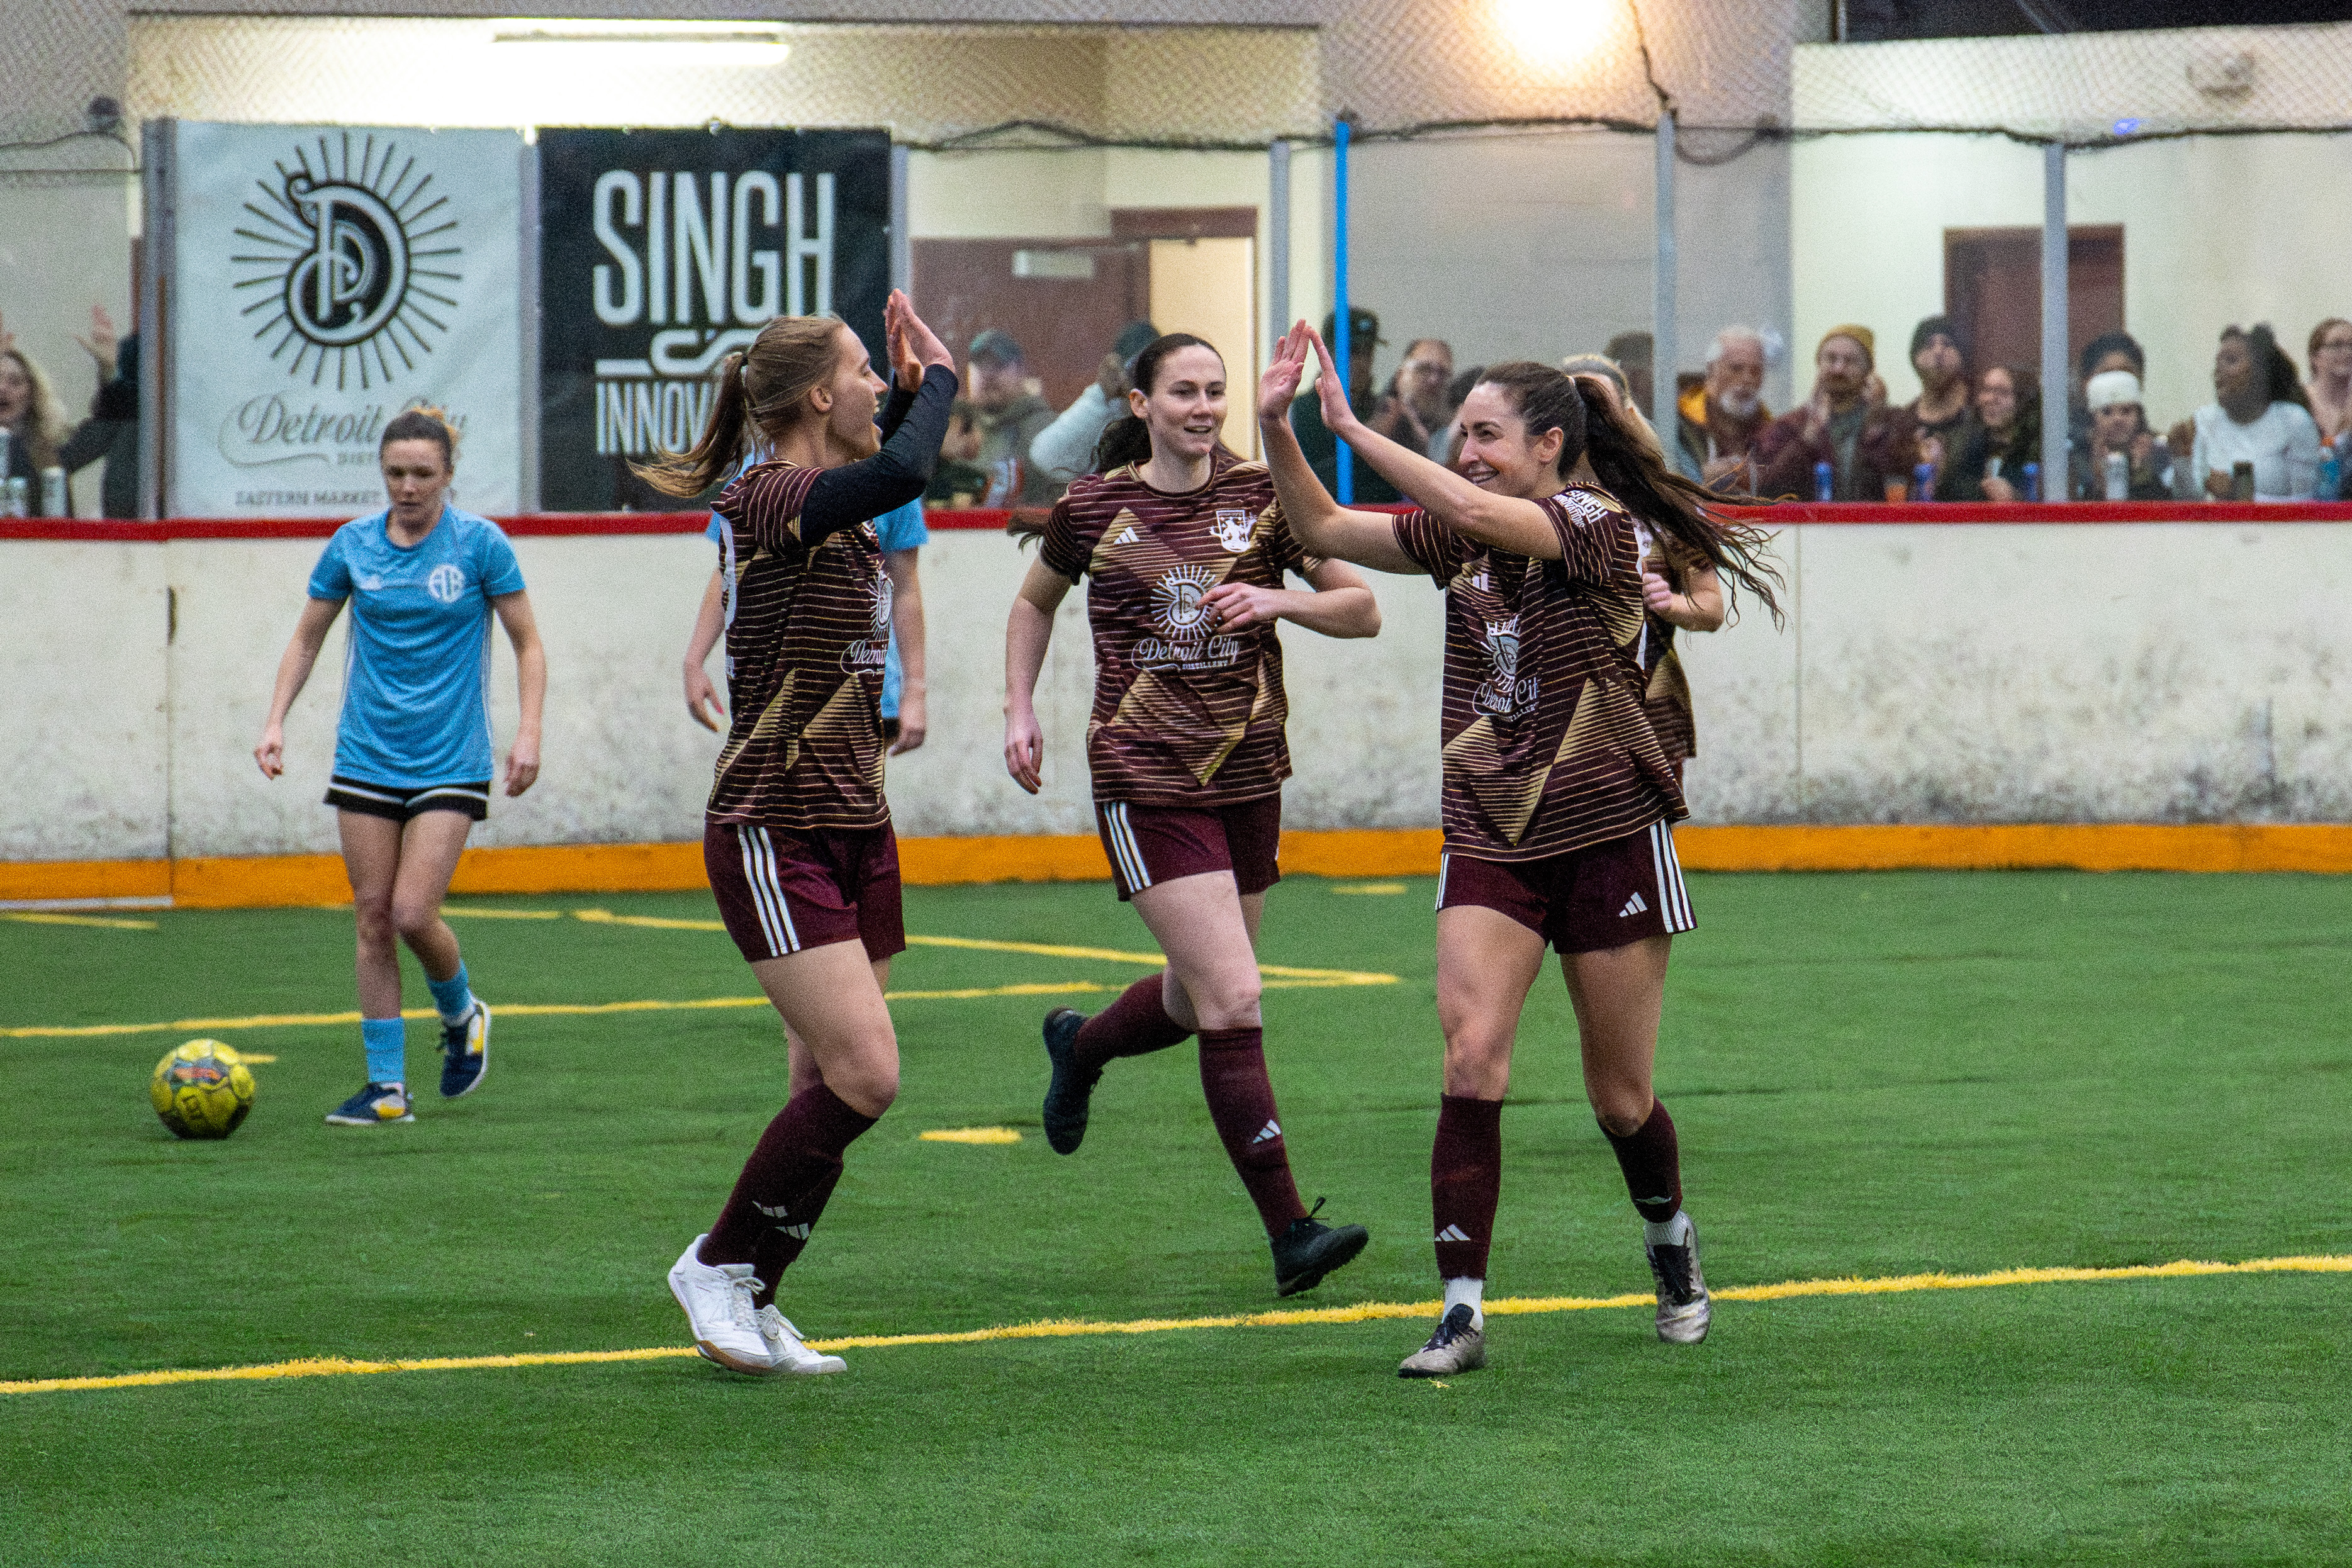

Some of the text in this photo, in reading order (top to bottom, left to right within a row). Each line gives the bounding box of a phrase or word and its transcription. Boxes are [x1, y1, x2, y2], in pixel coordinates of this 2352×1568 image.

[593, 169, 836, 326] SINGH
[229, 393, 383, 445] Detroit
[595, 381, 719, 455] INNOV
[1565, 490, 1608, 523] SINGH
[1134, 635, 1240, 664] Detroit City
[1182, 660, 1228, 670] DISTILLERY
[1515, 676, 1540, 705] Cit
